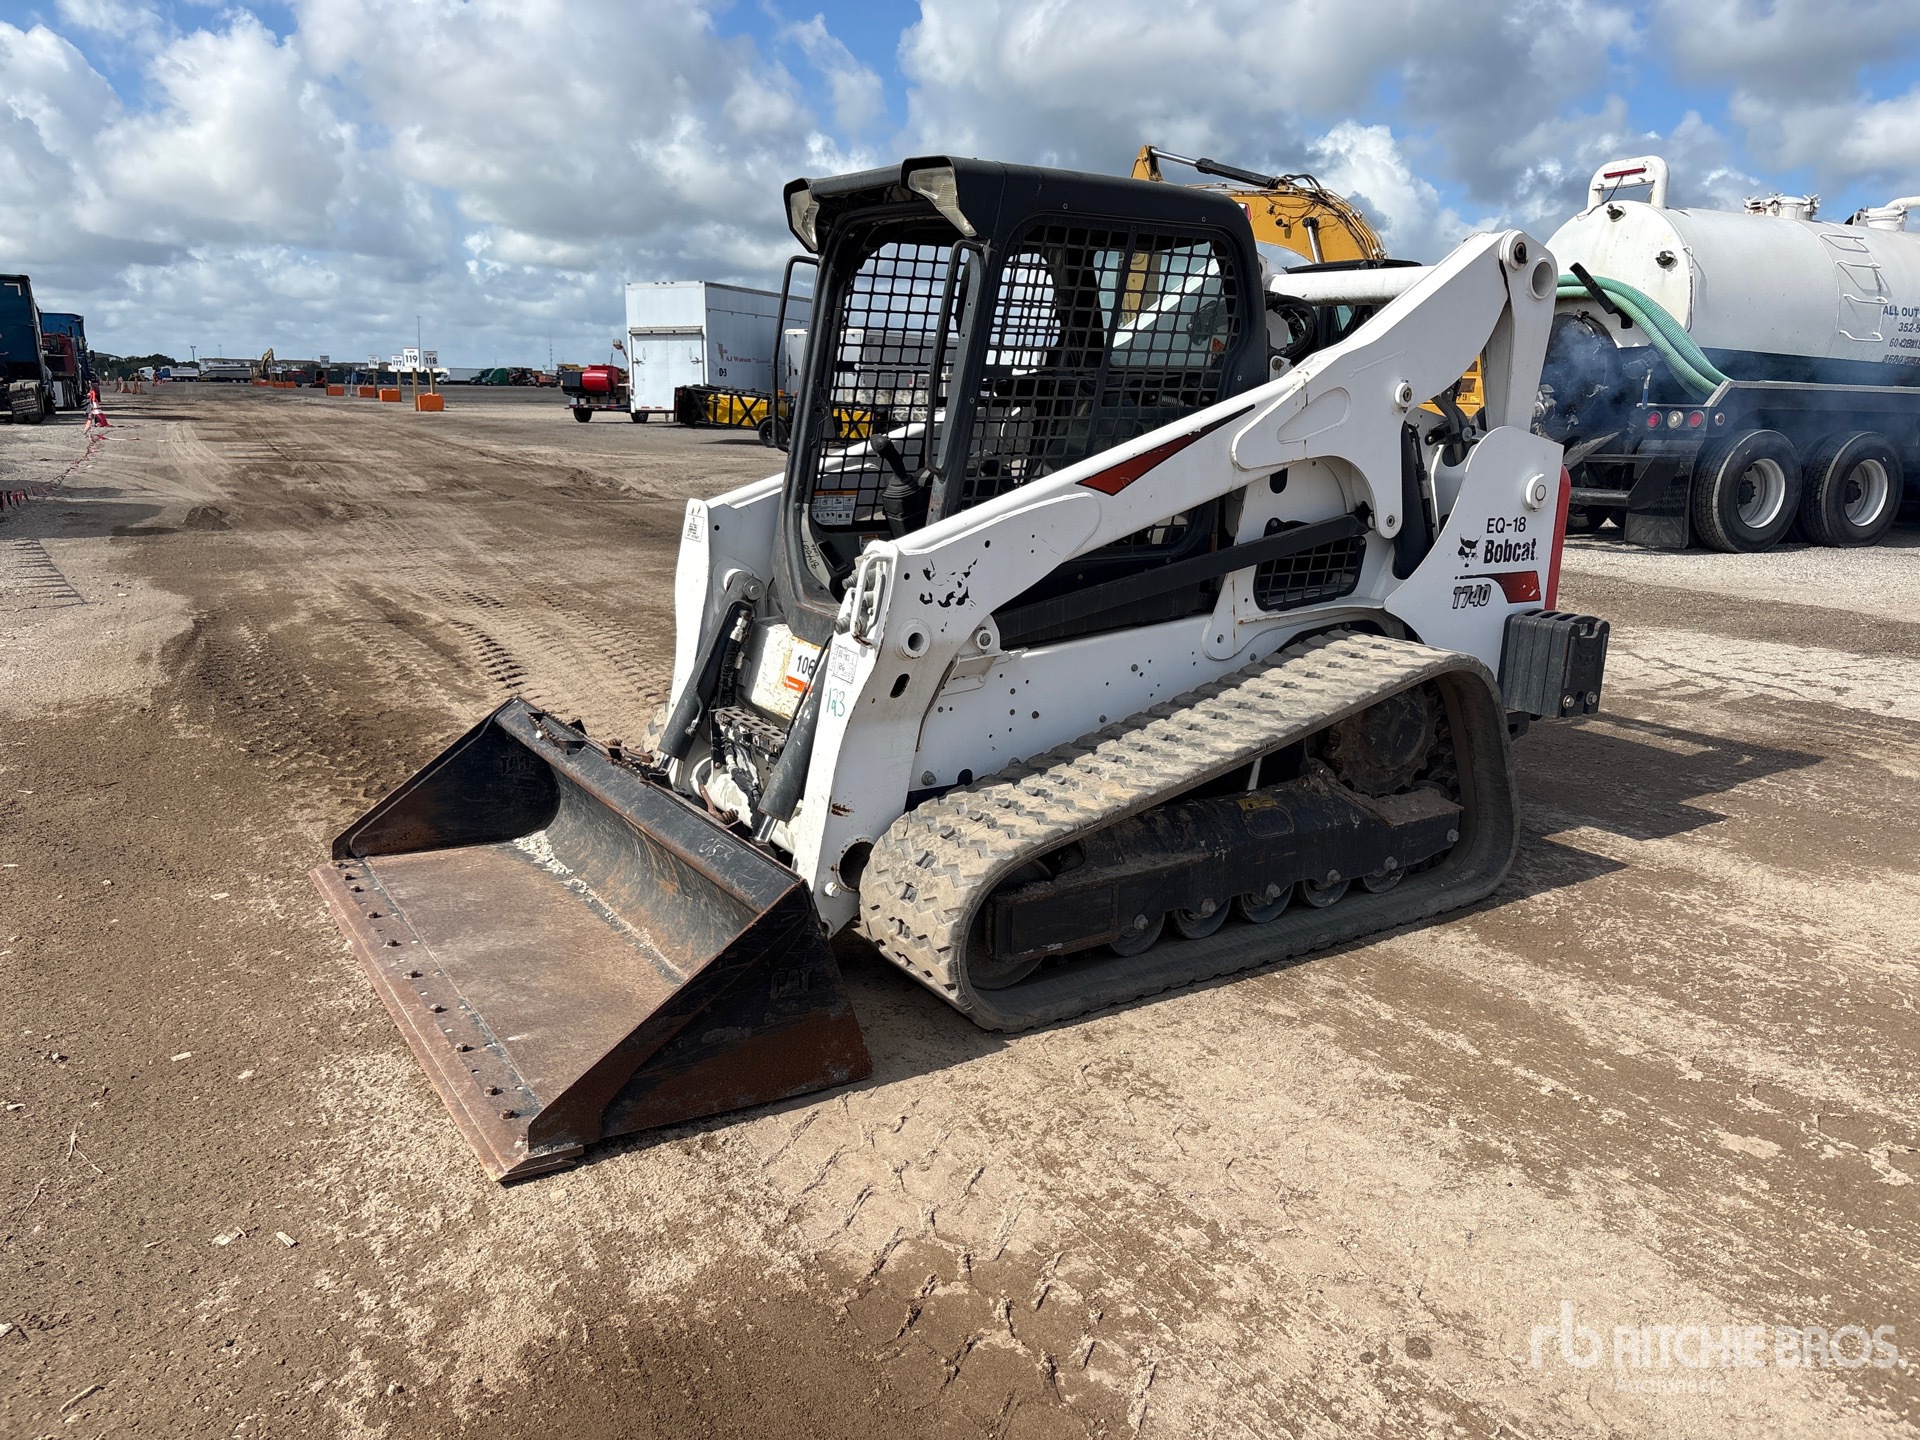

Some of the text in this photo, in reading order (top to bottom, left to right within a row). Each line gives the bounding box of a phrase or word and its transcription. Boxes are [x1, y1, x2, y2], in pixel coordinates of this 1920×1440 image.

[1883, 305, 1920, 317] ALL OUT
[393, 359, 402, 367] 117
[405, 354, 418, 364] 119
[425, 356, 438, 365] 118
[1486, 516, 1527, 534] EQ-18
[1483, 538, 1537, 564] Bobcat
[1452, 583, 1492, 609] T740
